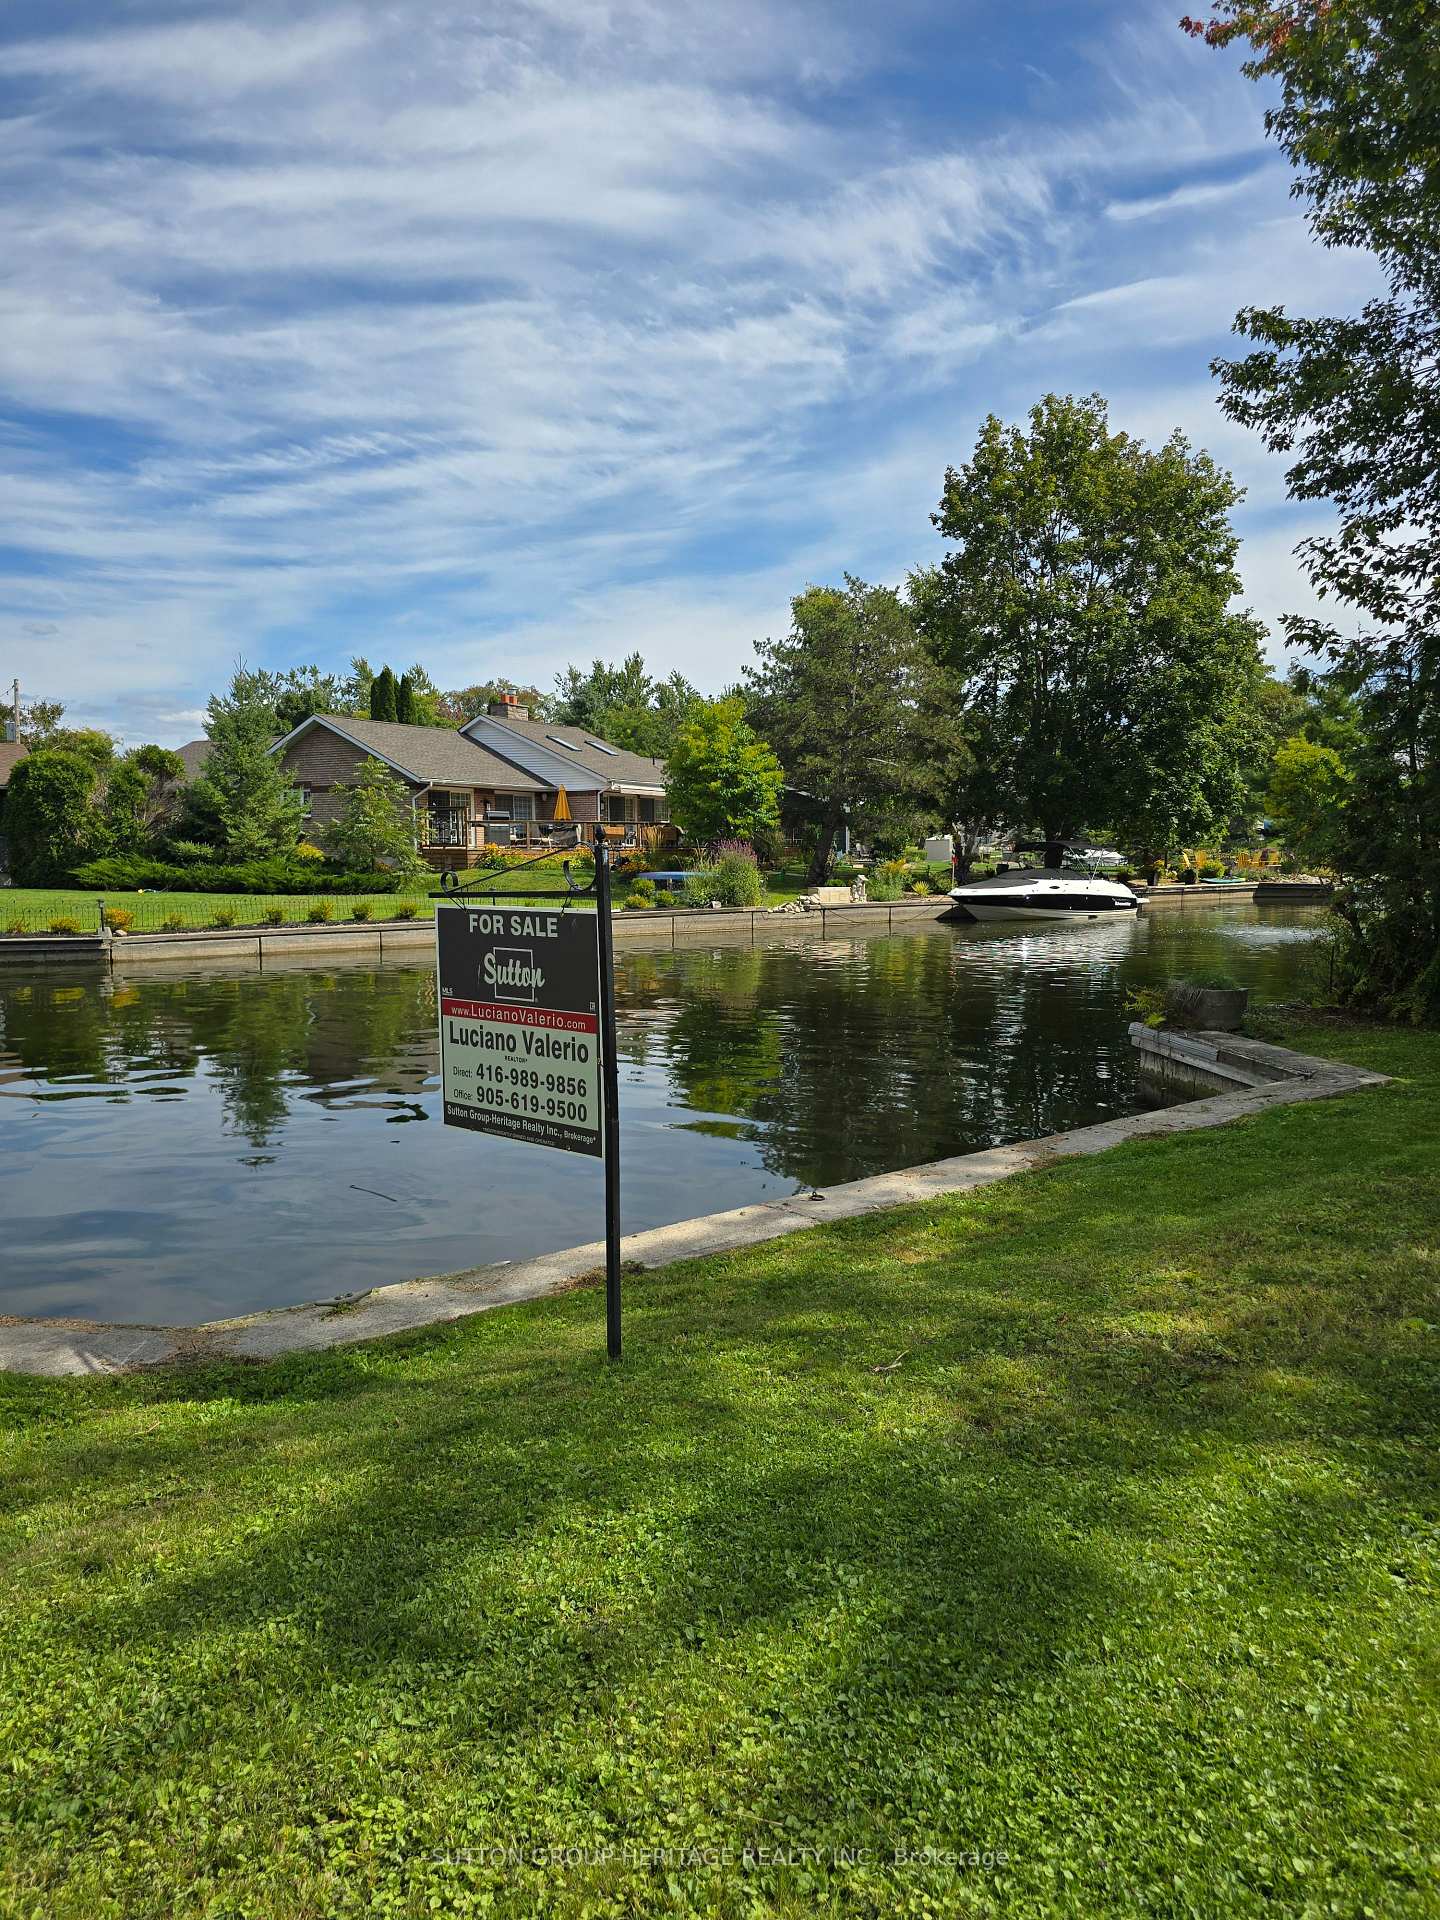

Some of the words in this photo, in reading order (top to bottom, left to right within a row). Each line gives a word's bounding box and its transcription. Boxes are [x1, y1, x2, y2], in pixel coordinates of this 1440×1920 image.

[469, 914, 504, 935] FOR
[510, 915, 559, 938] SALE
[483, 952, 546, 988] Sutton
[450, 1003, 586, 1030] www.LucianoValerio.com
[449, 1020, 517, 1053] Luciano
[521, 1030, 589, 1064] Valerio
[452, 1065, 473, 1079] Direct:
[476, 1063, 587, 1097] 416-989-9856
[447, 1104, 468, 1117] Sutton
[469, 1109, 521, 1130] Group-Heritage
[522, 1119, 545, 1136] Realty
[453, 1088, 473, 1101] Office:
[476, 1086, 587, 1122] 905-619-9500
